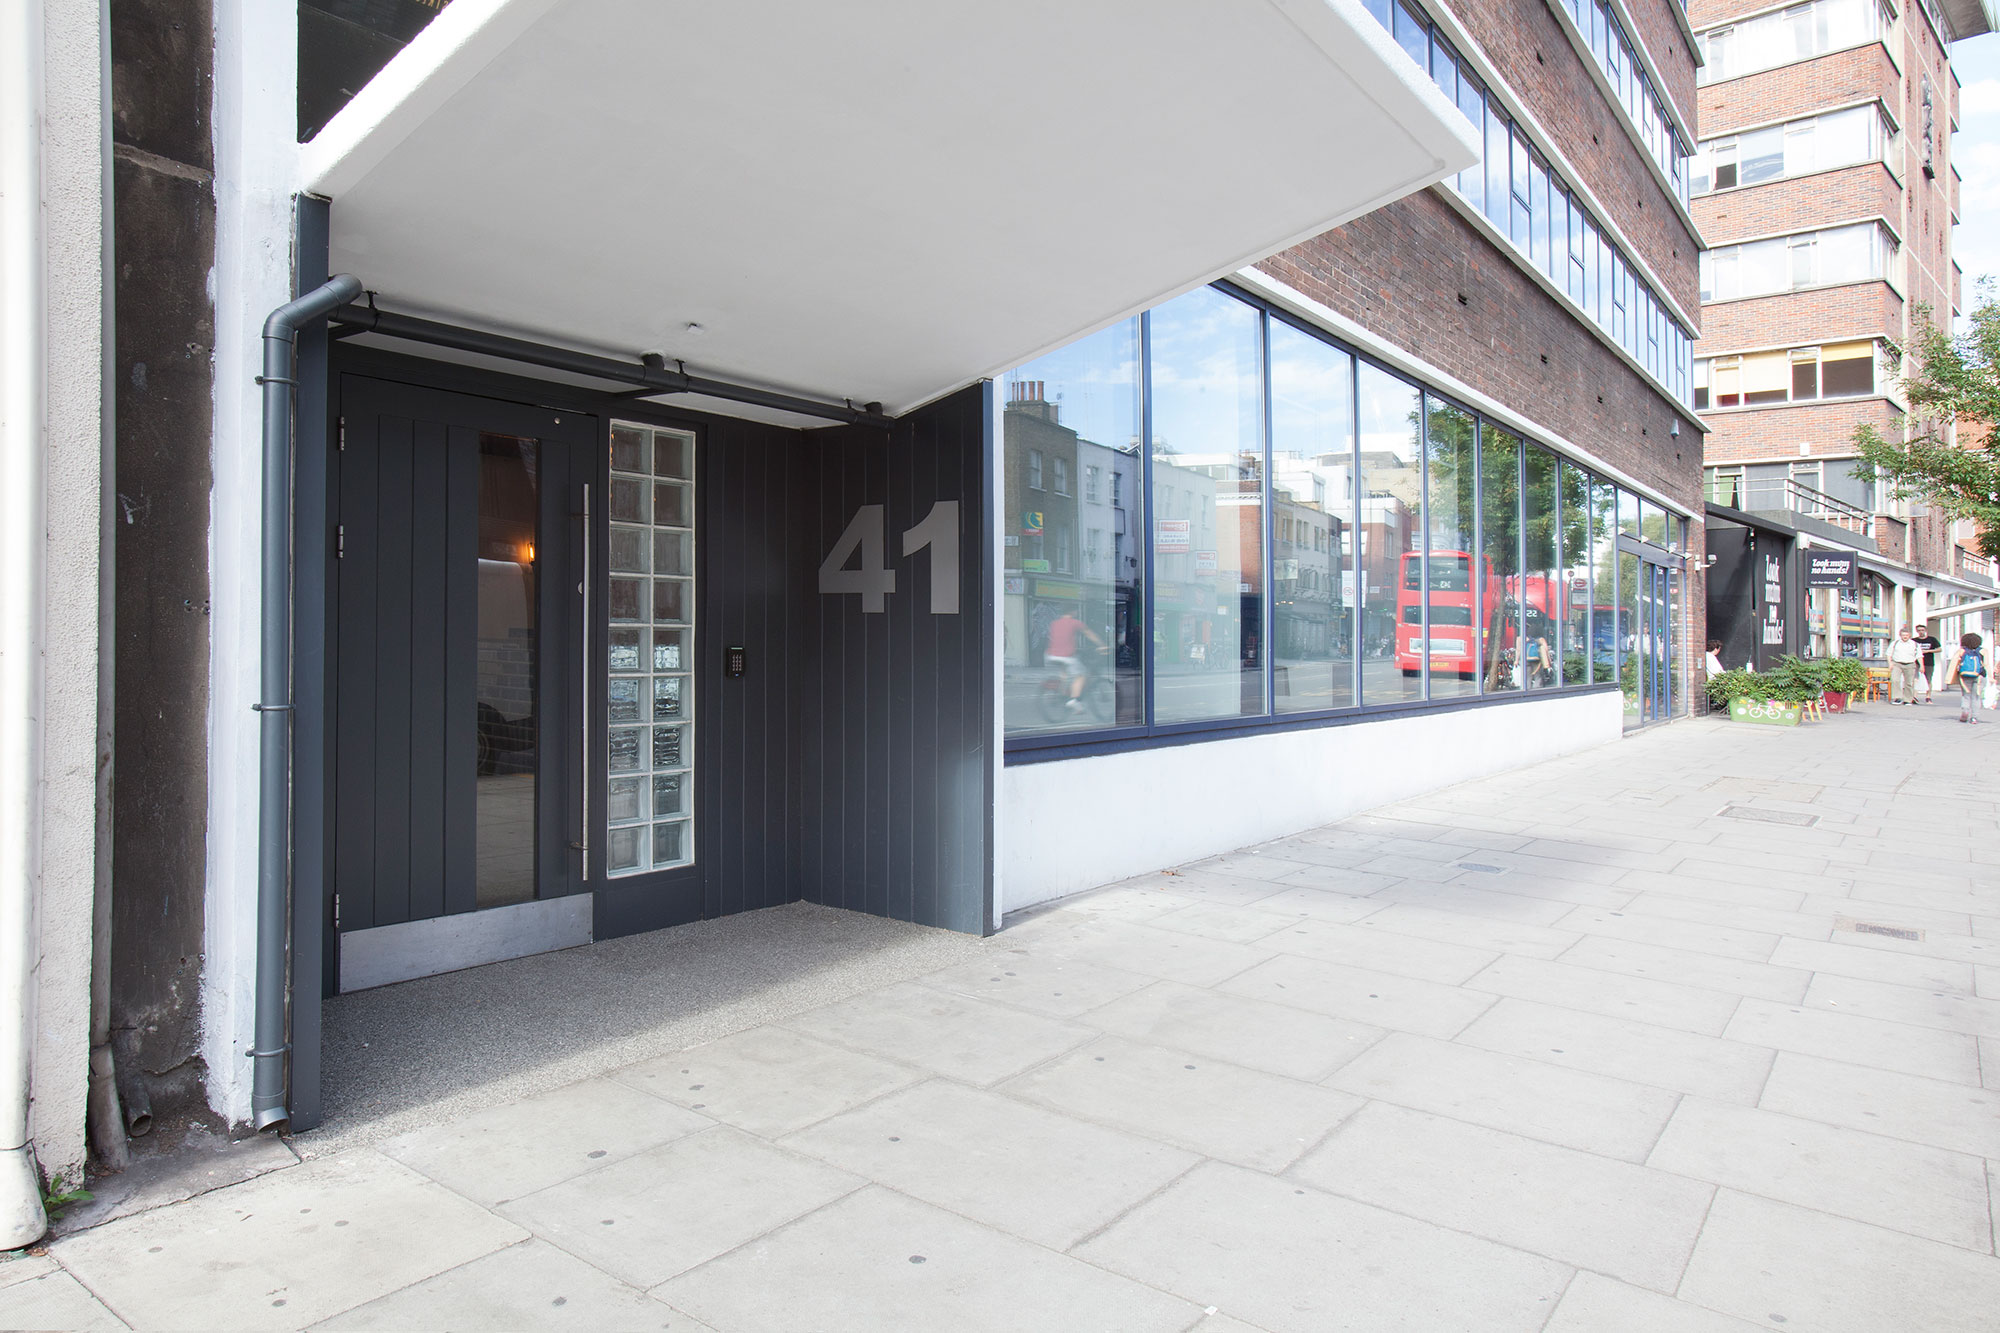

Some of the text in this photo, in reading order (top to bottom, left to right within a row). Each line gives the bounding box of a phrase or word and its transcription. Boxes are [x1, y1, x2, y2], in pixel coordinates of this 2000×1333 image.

[818, 500, 959, 614] 41
[1765, 554, 1780, 582] Look
[1812, 558, 1830, 567] Look
[1821, 566, 1849, 575] hands!
[1762, 618, 1784, 645] hands!
